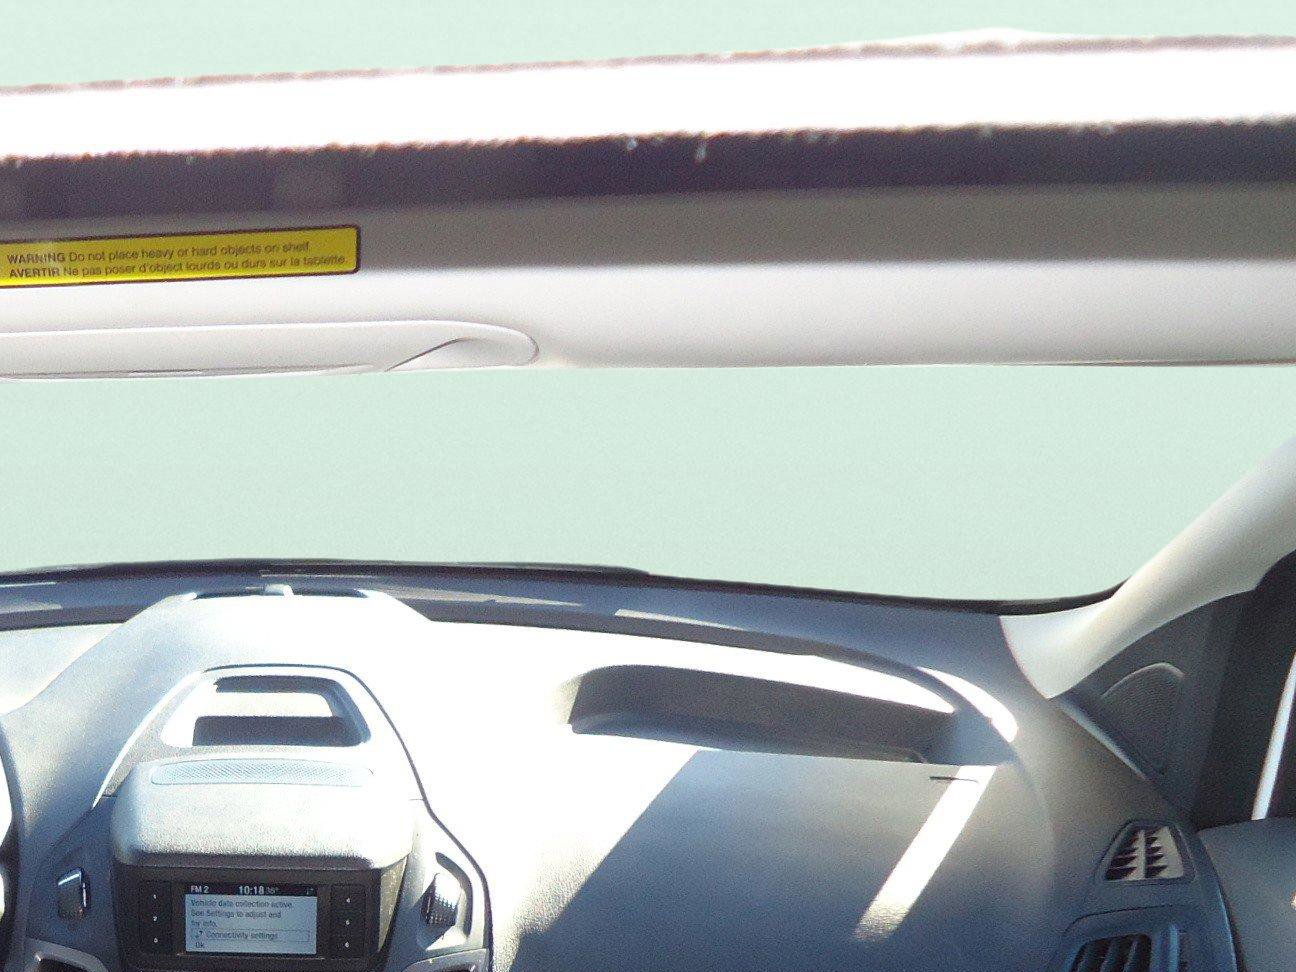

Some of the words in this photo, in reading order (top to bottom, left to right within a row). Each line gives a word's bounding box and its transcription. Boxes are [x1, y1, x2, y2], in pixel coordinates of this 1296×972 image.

[7, 252, 65, 264] WARNING
[69, 252, 84, 262] Do
[88, 251, 104, 261] not
[109, 250, 138, 263] place
[142, 248, 173, 261] heavy
[221, 244, 261, 257] objects
[9, 268, 59, 279] AVERTIR
[64, 268, 79, 276] Ne
[105, 265, 135, 277] poser
[238, 885, 264, 895] 10:18
[235, 900, 269, 908] collection
[206, 909, 234, 919] Settings
[206, 931, 249, 940] Connectivity
[250, 931, 278, 941] settings
